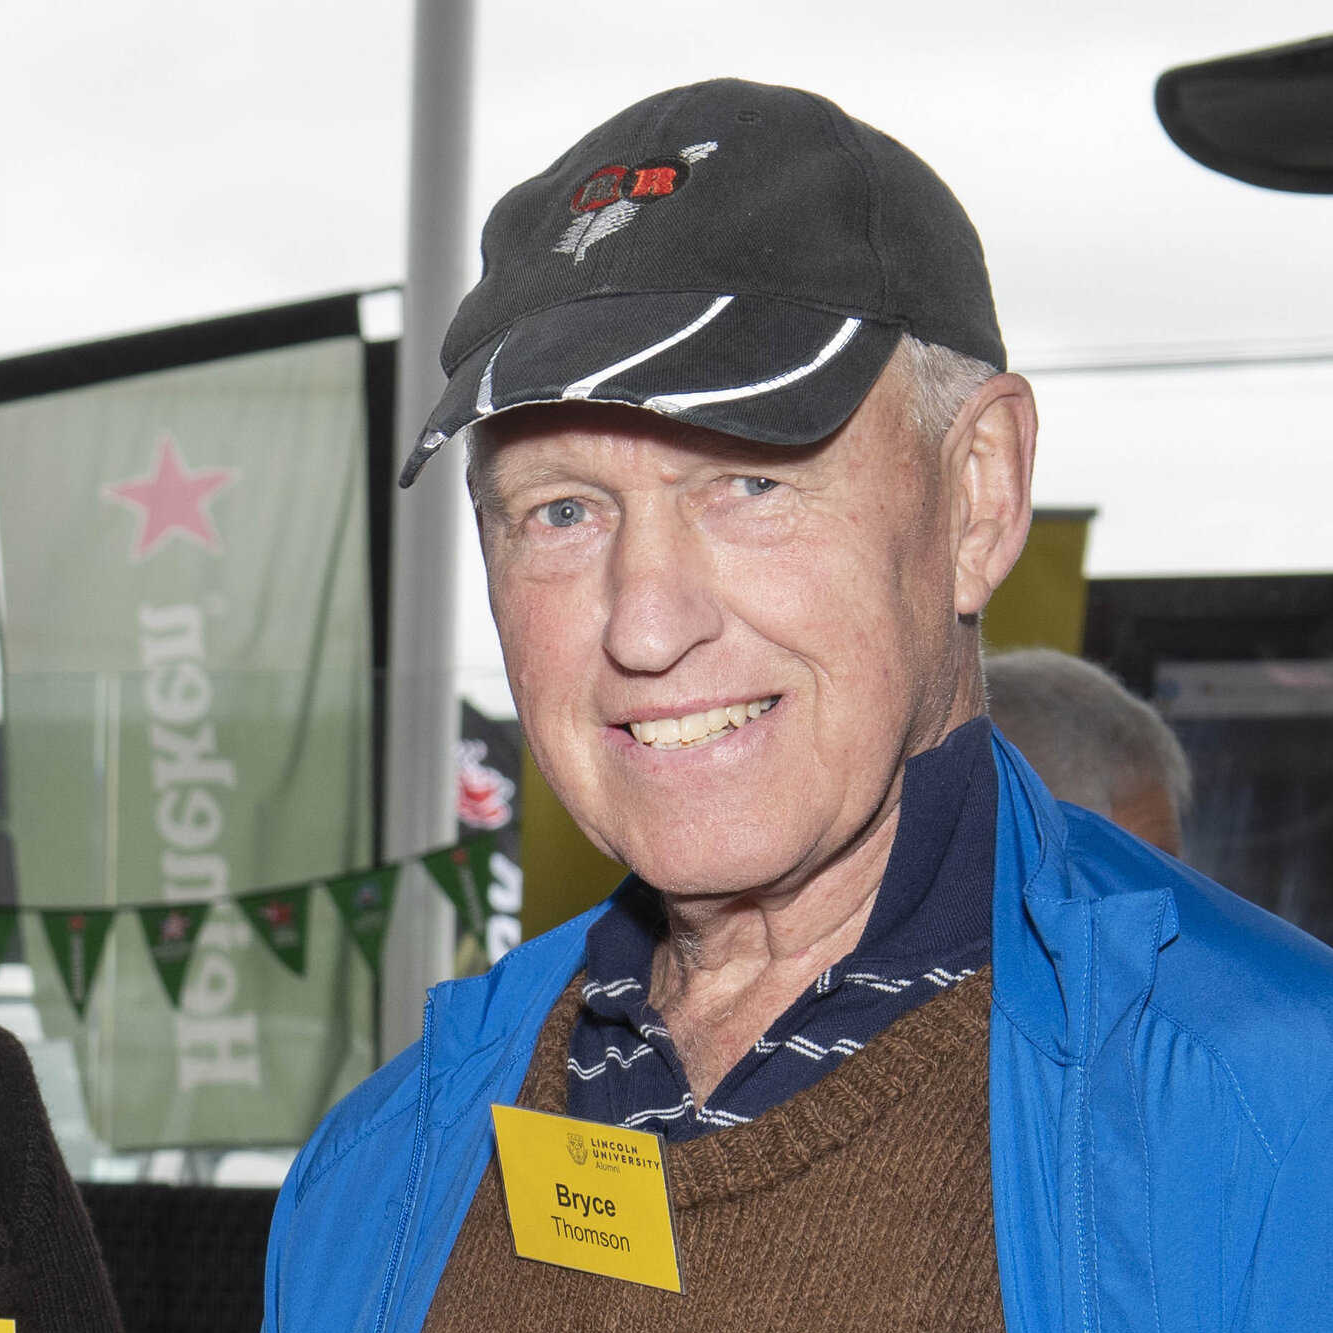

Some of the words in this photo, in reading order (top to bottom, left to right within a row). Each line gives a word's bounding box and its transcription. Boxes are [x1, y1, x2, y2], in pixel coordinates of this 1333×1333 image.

[590, 1137, 639, 1155] LINCOLN
[592, 1151, 661, 1171] UNIVERSITY
[595, 1161, 621, 1174] Alumni
[555, 1183, 617, 1218] Bryce
[551, 1215, 631, 1253] Thomson
